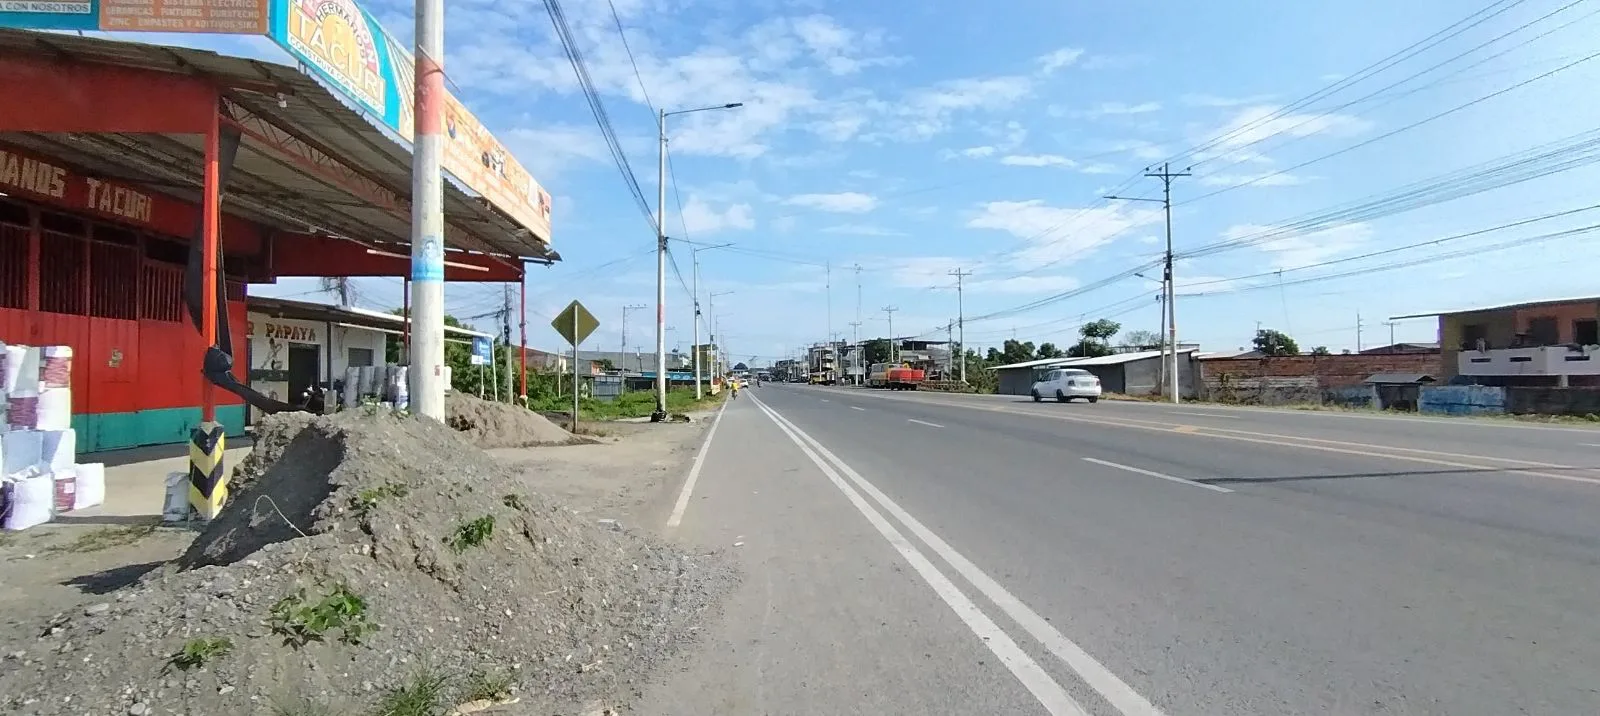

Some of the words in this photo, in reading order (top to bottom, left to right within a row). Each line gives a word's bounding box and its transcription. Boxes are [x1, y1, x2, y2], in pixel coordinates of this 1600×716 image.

[6, 2, 28, 10] CON
[31, 3, 89, 12] NOSOTROS
[293, 8, 384, 105] TACURI
[87, 177, 153, 222] TACURI
[265, 323, 316, 342] PAPAYA
